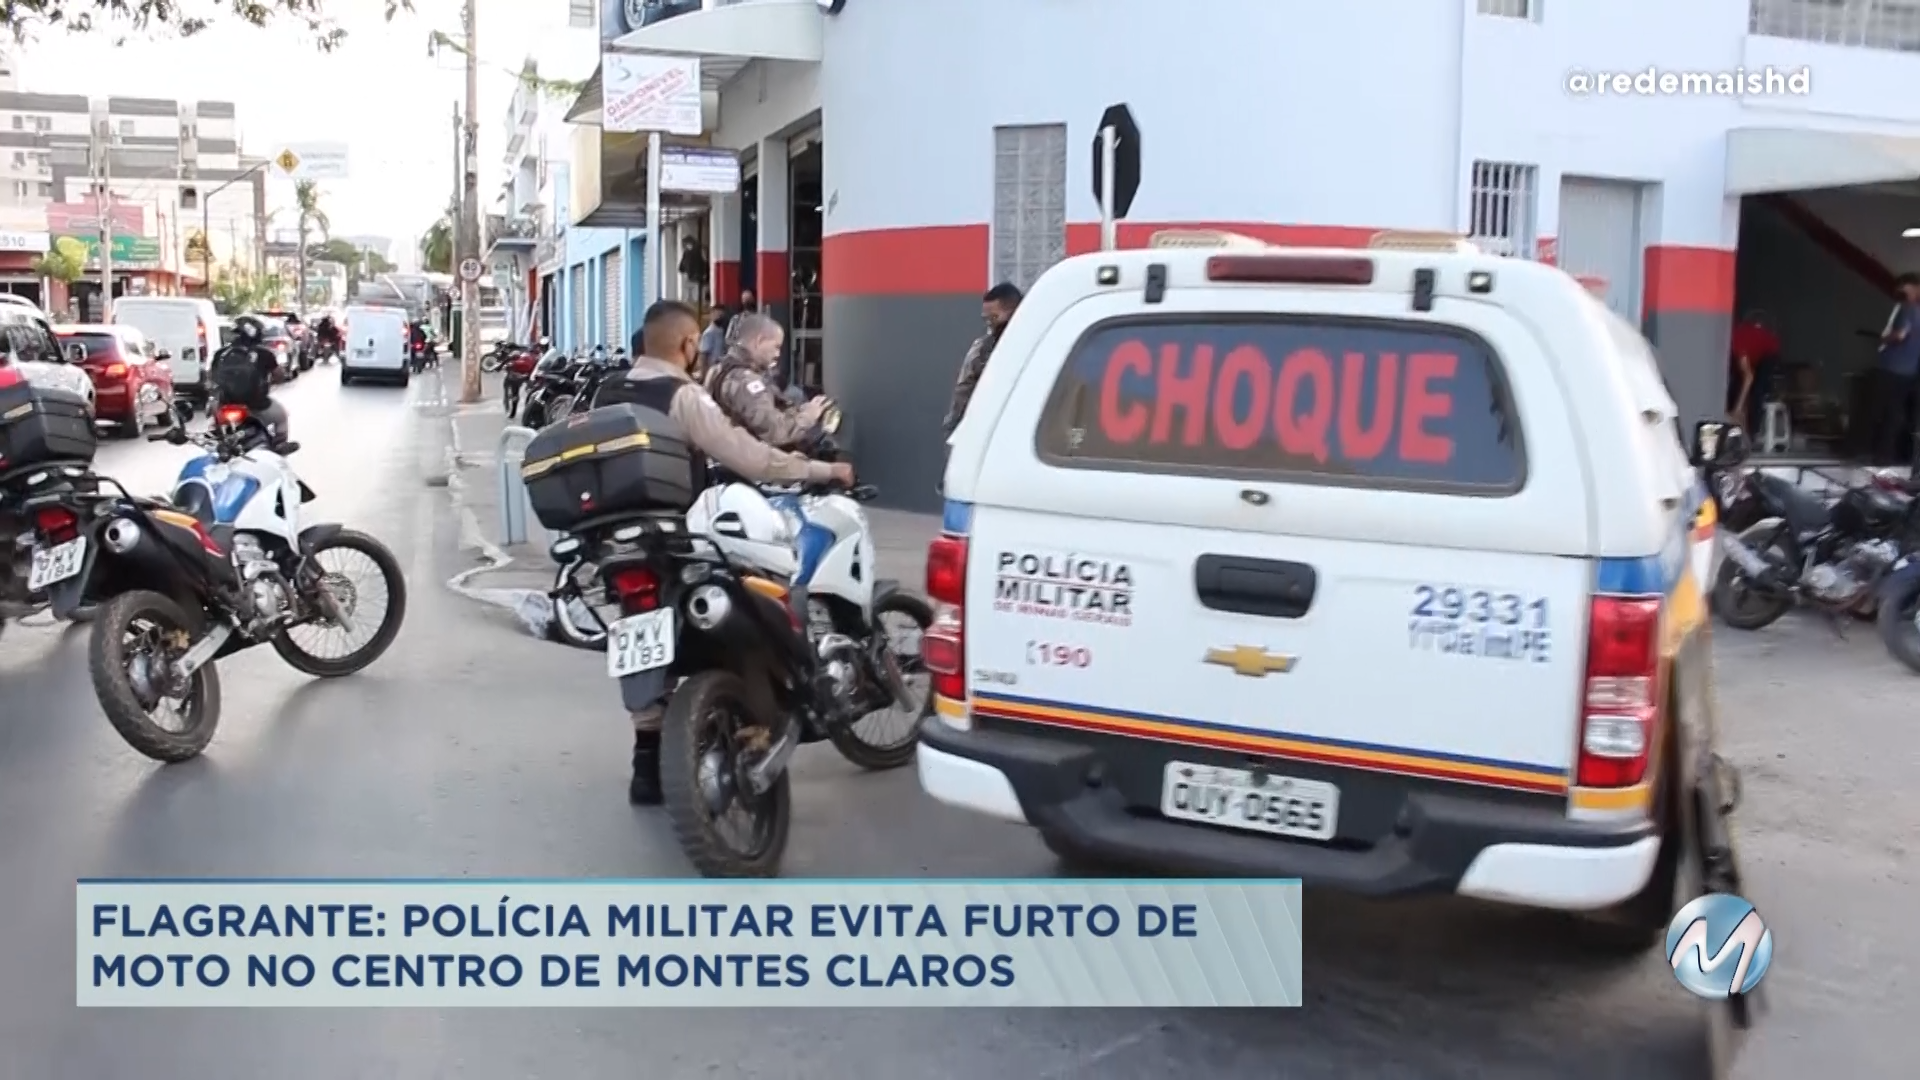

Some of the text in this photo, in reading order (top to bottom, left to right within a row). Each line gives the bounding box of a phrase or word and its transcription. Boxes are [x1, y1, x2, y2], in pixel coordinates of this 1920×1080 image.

[1101, 339, 1458, 464] CHOQUE
[997, 551, 1133, 587] POLÍCIA
[995, 579, 1132, 615] MILITAR
[1410, 584, 1547, 628] 29331
[1038, 642, 1092, 669] 190
